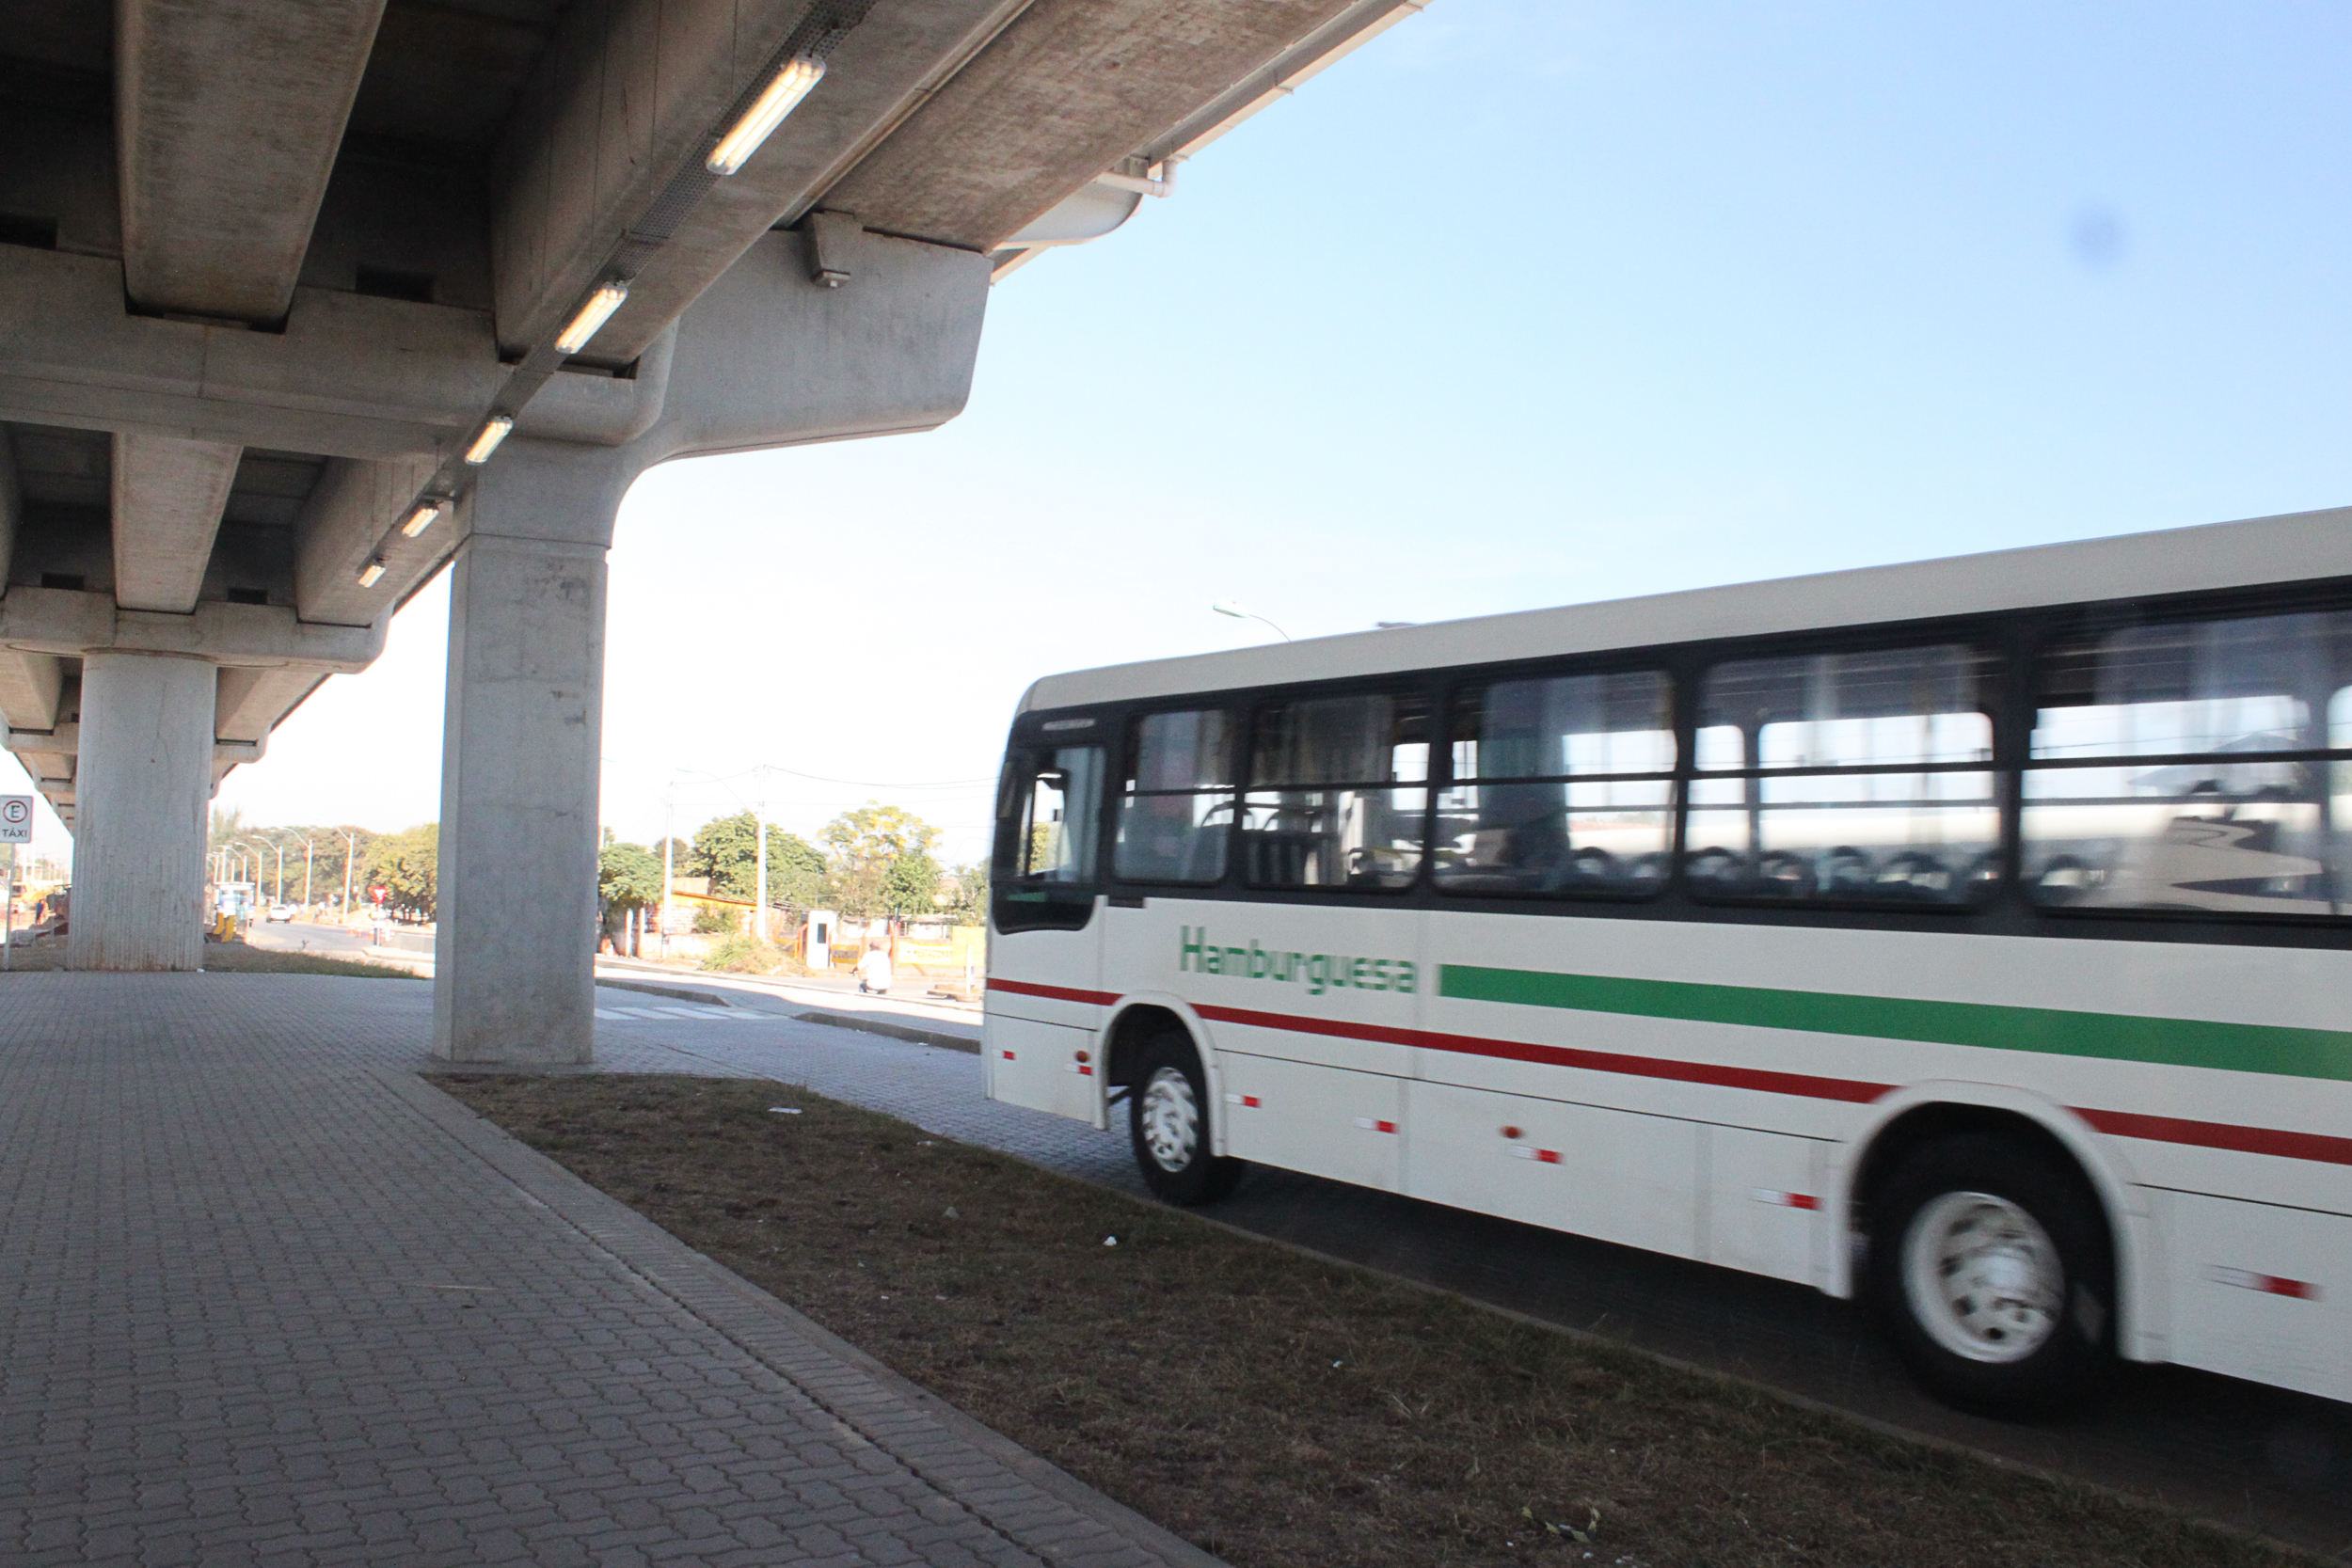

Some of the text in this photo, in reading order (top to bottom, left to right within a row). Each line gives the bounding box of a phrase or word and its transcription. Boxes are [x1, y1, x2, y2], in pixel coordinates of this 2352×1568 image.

[10, 805, 20, 818] E
[2, 828, 27, 837] TÁXI
[1181, 926, 1418, 995] Hamburguesa
